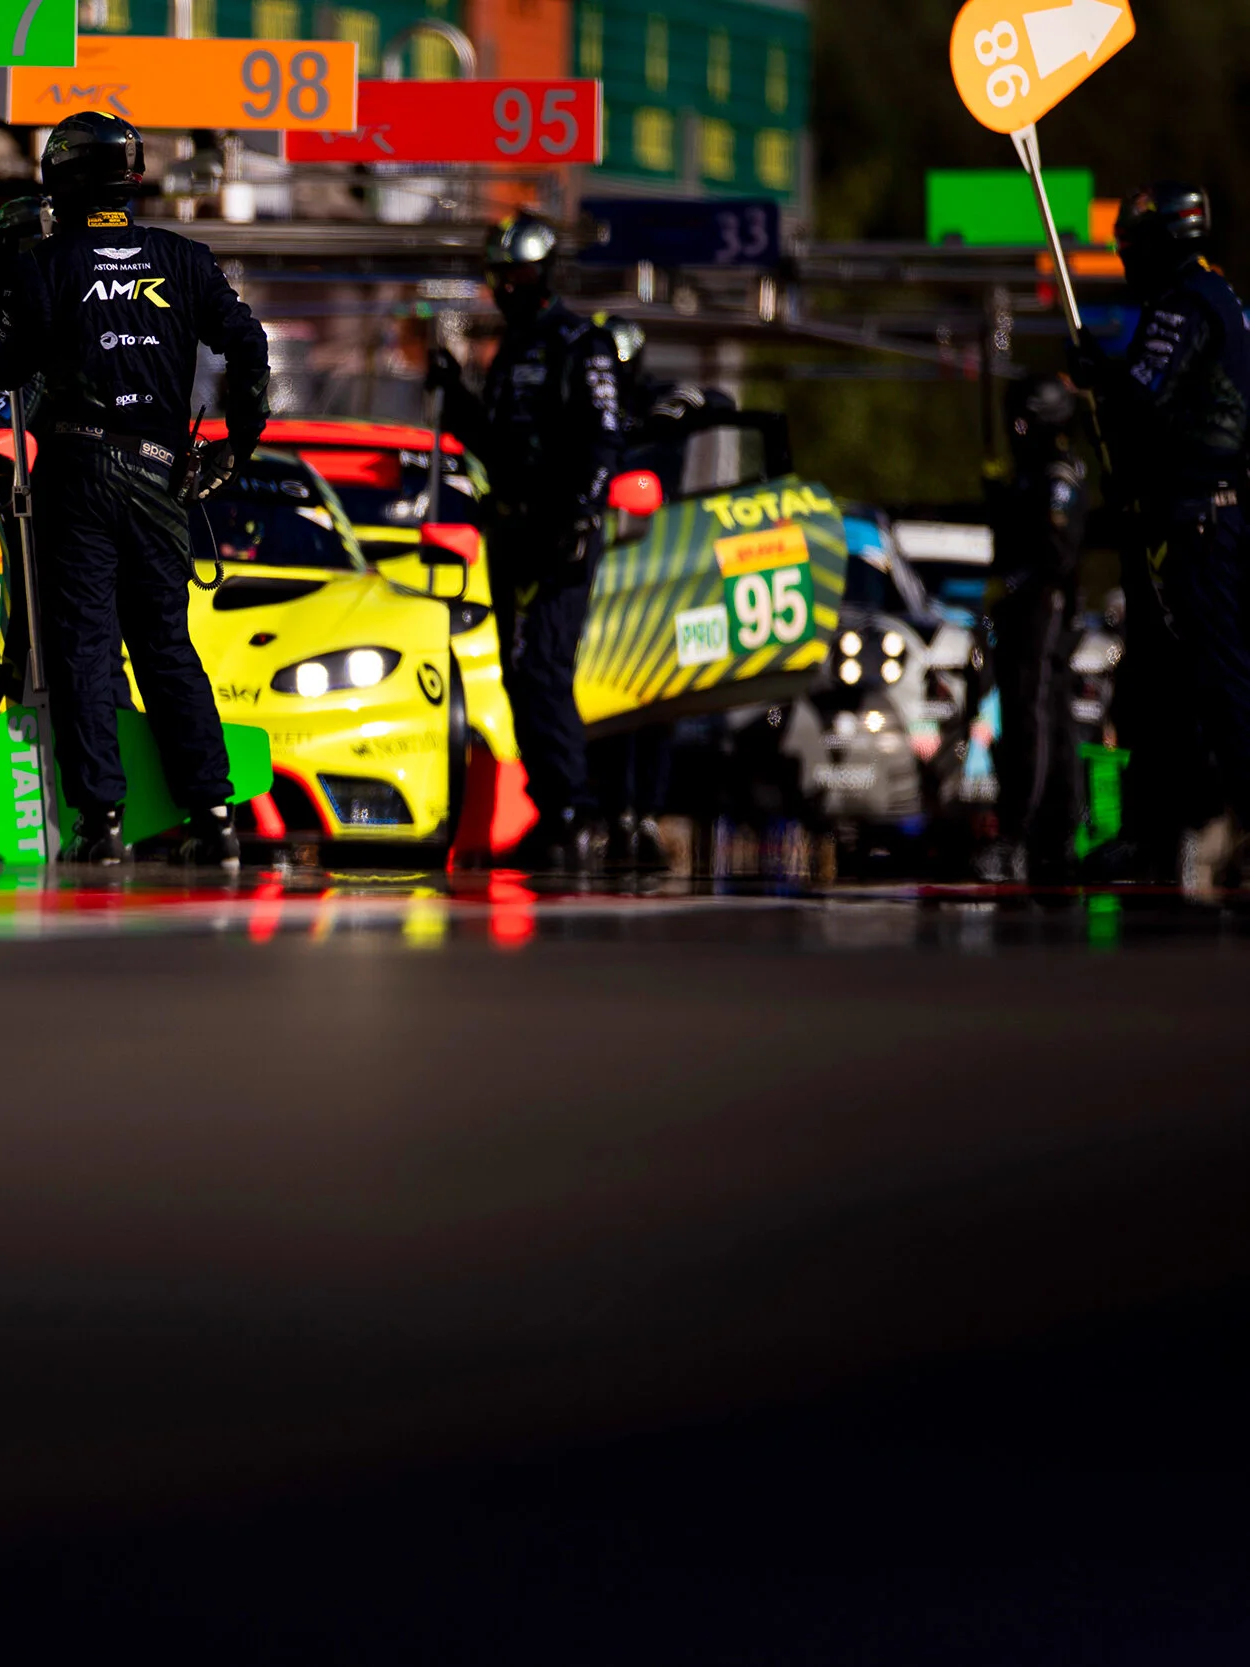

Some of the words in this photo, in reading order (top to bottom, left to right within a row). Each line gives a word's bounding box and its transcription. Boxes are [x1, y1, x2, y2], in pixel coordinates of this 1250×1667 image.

[36, 83, 130, 115] AMR
[241, 50, 330, 120] 98
[493, 88, 579, 154] 95
[715, 208, 768, 262] 33
[94, 263, 119, 271] ASTON
[120, 262, 151, 271] MARTIN
[82, 278, 171, 307] AMR
[118, 334, 160, 346] TOTAL
[703, 485, 832, 529] TOTAL
[734, 566, 808, 650] 95
[218, 686, 261, 705] sky
[8, 714, 46, 858] START
